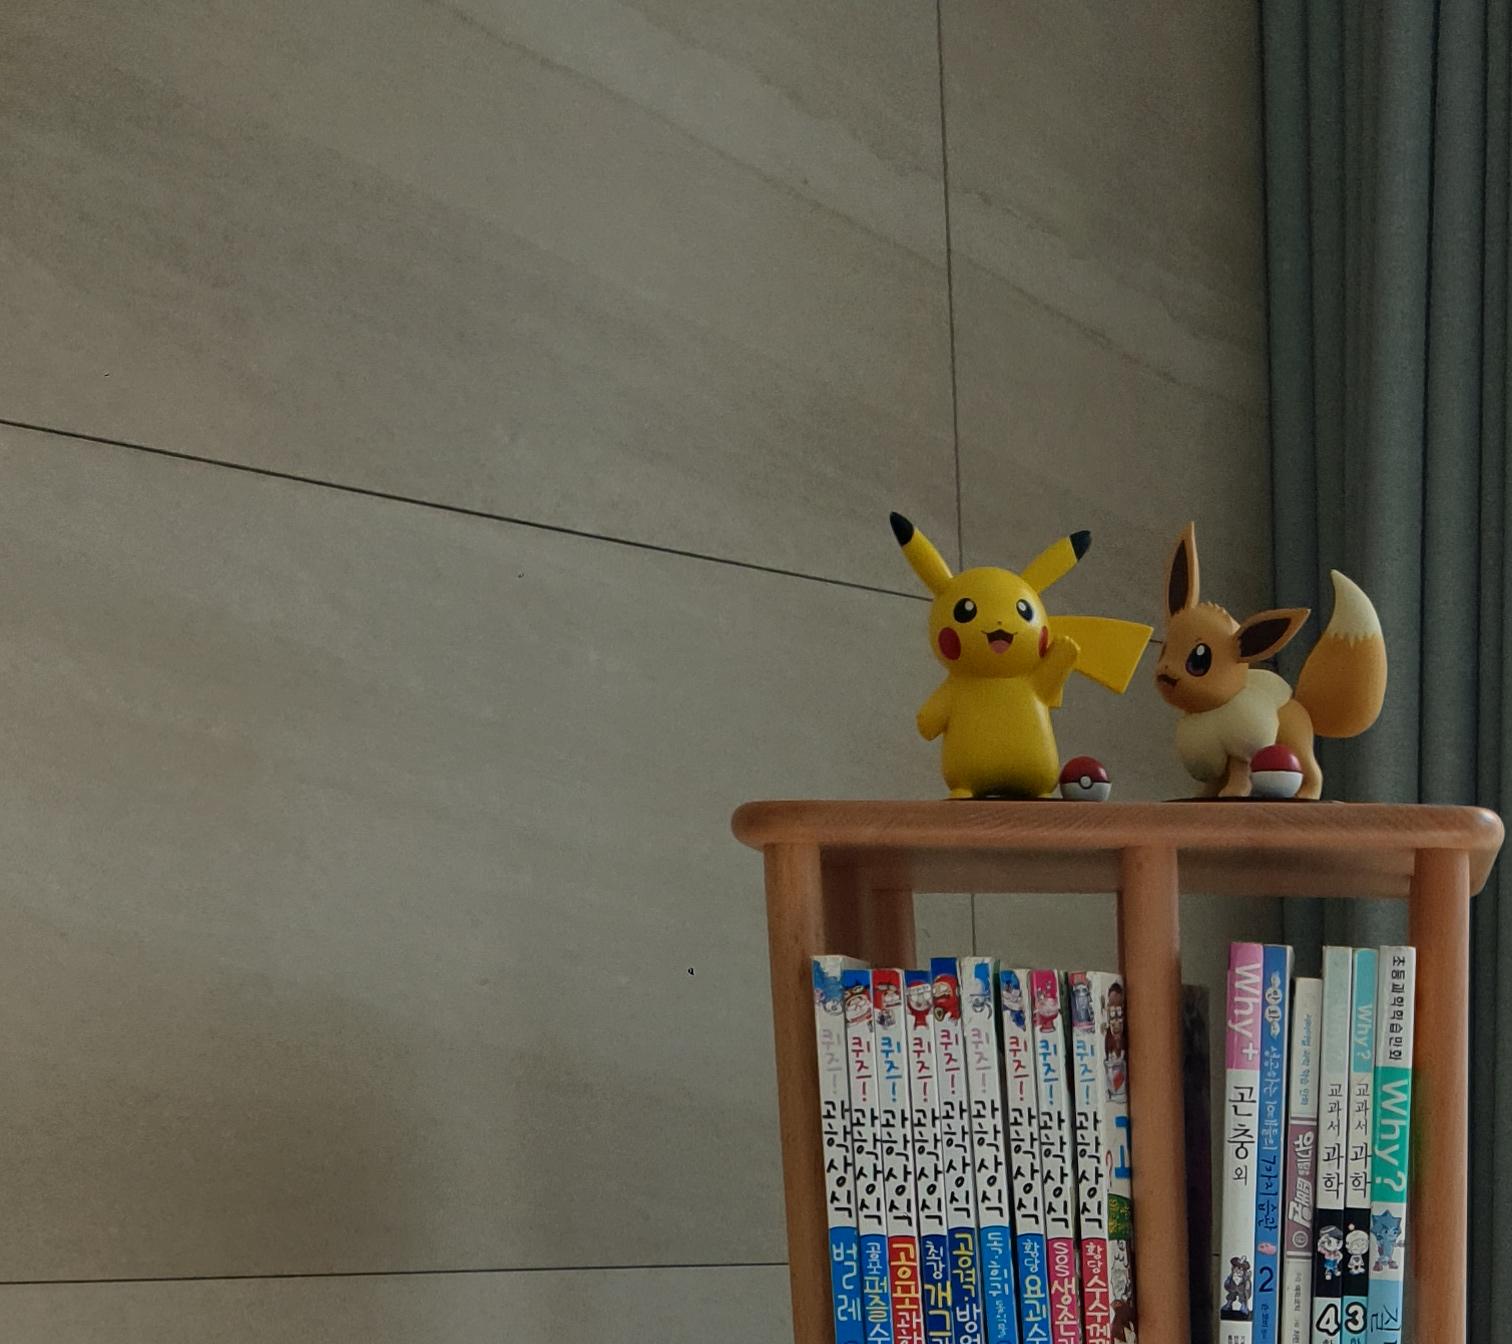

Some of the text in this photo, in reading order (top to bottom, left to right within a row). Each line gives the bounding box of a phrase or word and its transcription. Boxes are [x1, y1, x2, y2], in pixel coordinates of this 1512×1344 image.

[1354, 1003, 1374, 1060] Why?
[1389, 955, 1406, 1061] 초등과학학습만화
[822, 1100, 852, 1218] 과학상식
[851, 1036, 882, 1226] 퀴즈! 과학상식
[880, 1036, 913, 1227] 퀴즈! 과학상식
[912, 1036, 944, 1226] 퀴즈! 과학상식
[939, 1028, 972, 1219] 퀴즈! 과학상식
[971, 1100, 1004, 1218] 과학상식
[1008, 1036, 1040, 1226] 퀴즈! 과학상식
[1038, 1039, 1070, 1230] 퀴즈! 과학상식
[1076, 1039, 1104, 1229] 퀴즈! 과학상식
[1227, 1086, 1257, 1186] 곤충 외
[1322, 1083, 1344, 1199] 교과서 과학
[1350, 1083, 1372, 1199] 교과서 과학
[1374, 1079, 1409, 1194] Why?
[865, 1242, 883, 1275] 공포
[1022, 1238, 1040, 1273] 황당
[1053, 1242, 1070, 1278] SOS
[1085, 1241, 1103, 1274] 황당
[1257, 1200, 1278, 1230] 습관
[832, 1242, 862, 1322] 벌레
[864, 1276, 889, 1322] 퍼즐
[890, 1243, 919, 1309] 공포
[1023, 1274, 1046, 1322] 요괴
[1051, 1277, 1077, 1336] 생존
[1258, 1266, 1274, 1293] 2
[1315, 1303, 1341, 1337] 4
[1344, 1301, 1368, 1335] 3
